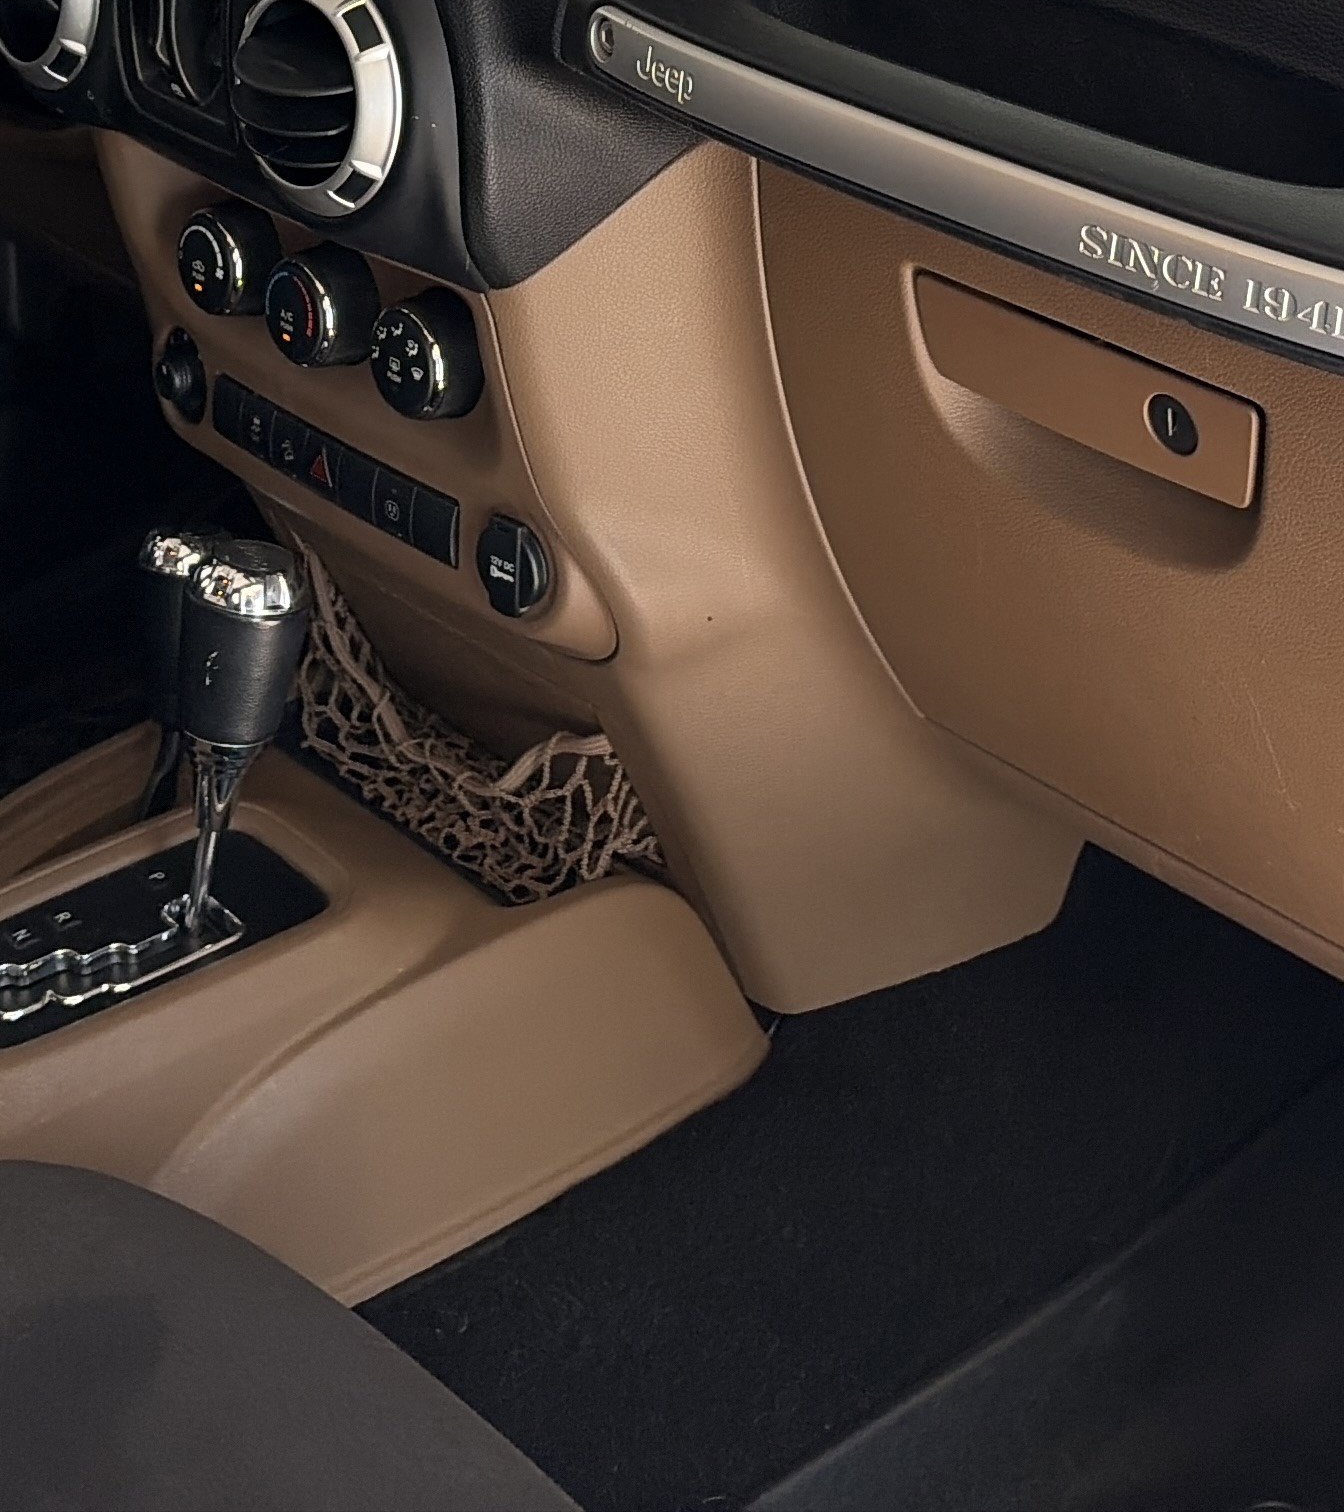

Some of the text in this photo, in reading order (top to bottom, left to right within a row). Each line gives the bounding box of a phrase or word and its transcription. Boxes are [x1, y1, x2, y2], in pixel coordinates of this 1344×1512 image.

[636, 45, 693, 104] Jeep
[1078, 223, 1226, 302] SINCE
[280, 308, 295, 322] A/C
[503, 560, 516, 573] DC
[148, 870, 165, 881] P
[54, 911, 71, 923] R
[12, 928, 31, 942] N
